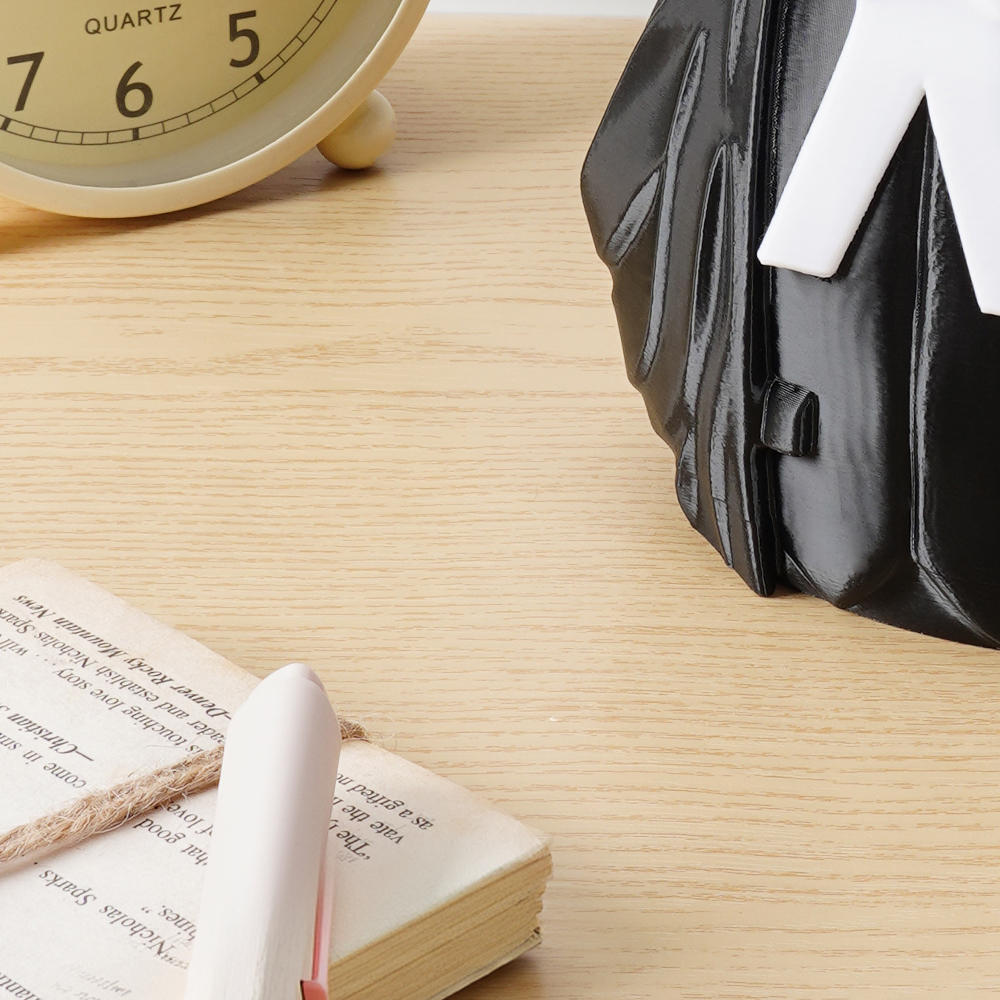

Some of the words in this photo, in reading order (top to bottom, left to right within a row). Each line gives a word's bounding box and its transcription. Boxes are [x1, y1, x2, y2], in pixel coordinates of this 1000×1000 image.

[84, 3, 182, 35] QUARTZ
[228, 9, 260, 68] 5
[6, 51, 45, 112] 7
[115, 60, 154, 118] 6
[12, 594, 56, 619] News
[33, 631, 98, 669] Nicholas
[52, 617, 128, 659] Mountain
[51, 667, 93, 691] story
[95, 665, 160, 703] establish
[123, 657, 174, 685] Rocky
[89, 688, 125, 711] love
[153, 701, 190, 720] and
[121, 705, 188, 746] touching
[22, 750, 44, 765] in
[42, 762, 87, 789] come
[346, 784, 405, 811] gifted
[341, 804, 371, 823] the
[398, 808, 413, 818] a
[411, 816, 434, 830] as
[132, 817, 186, 845] good
[369, 820, 405, 845] vate
[38, 869, 97, 906] Sparks
